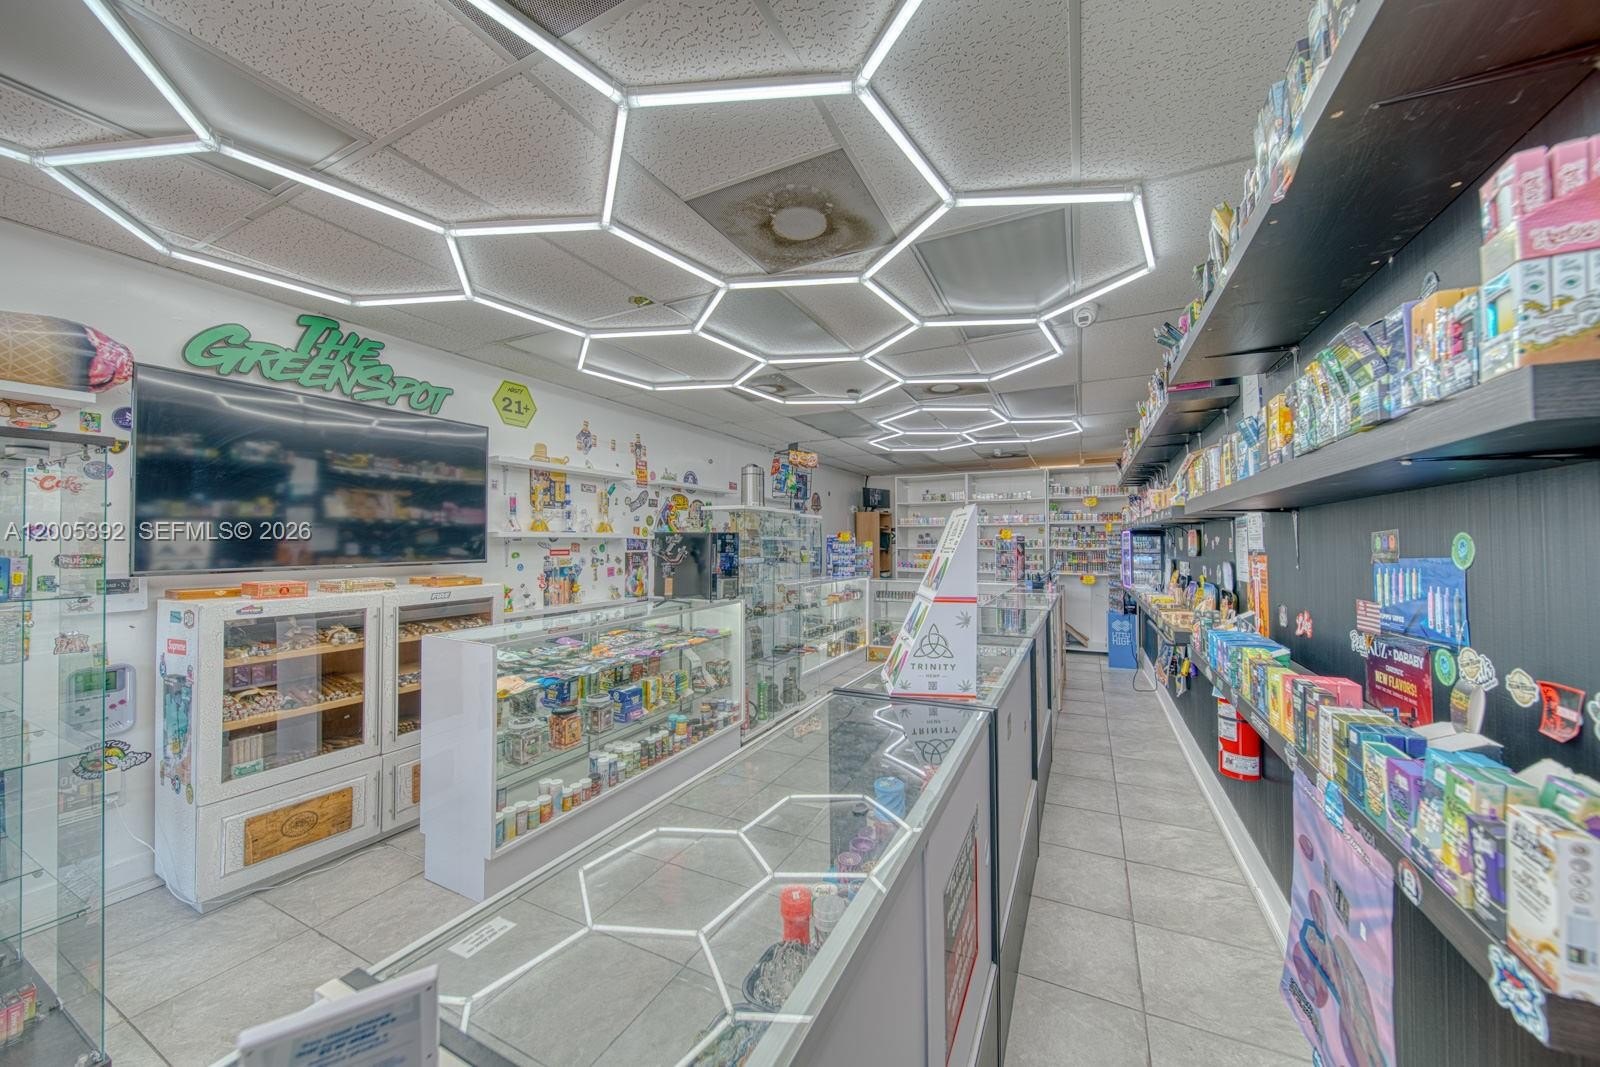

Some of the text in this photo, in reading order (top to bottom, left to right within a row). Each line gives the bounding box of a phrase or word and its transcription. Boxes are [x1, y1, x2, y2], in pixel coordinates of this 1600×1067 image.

[297, 314, 385, 368] THE
[182, 323, 454, 414] GREENSPOT
[502, 396, 530, 415] 21+
[910, 662, 957, 671] TRINITY
